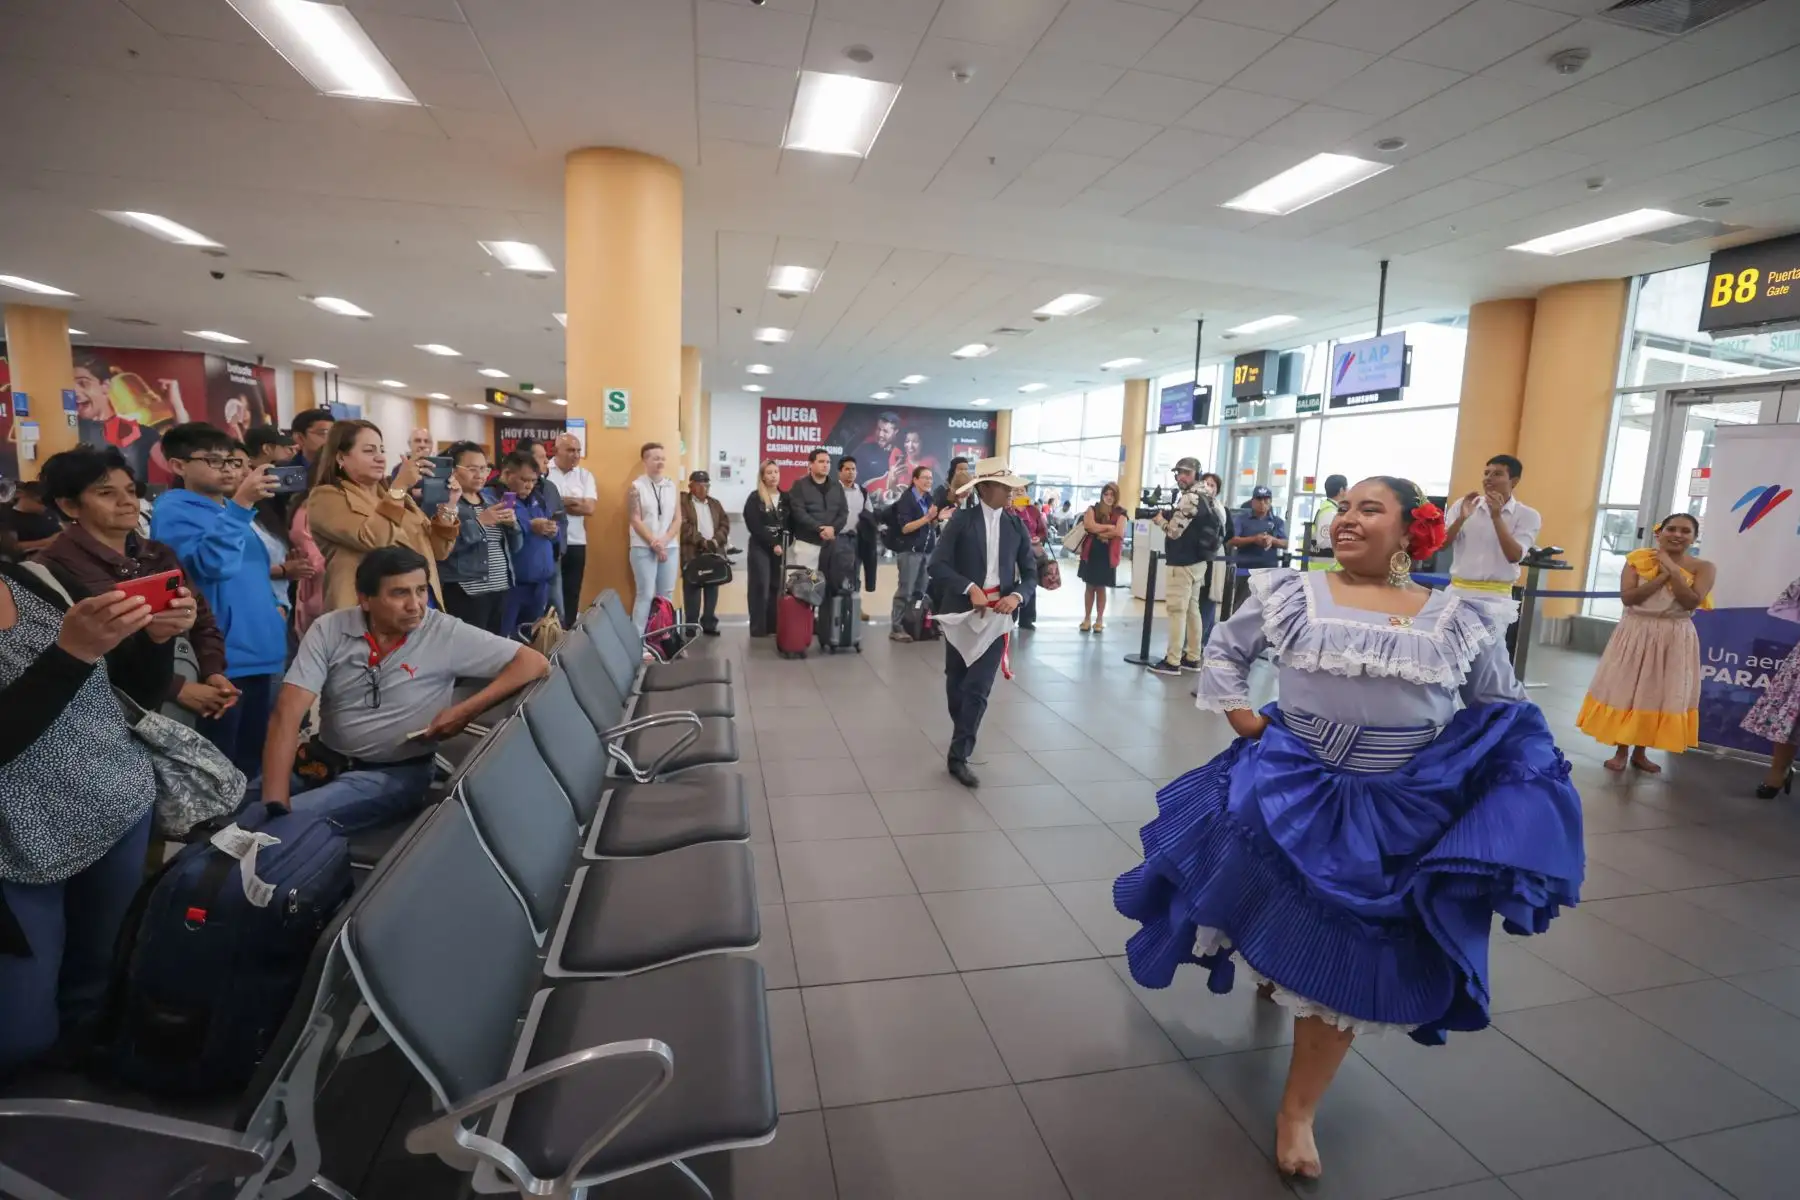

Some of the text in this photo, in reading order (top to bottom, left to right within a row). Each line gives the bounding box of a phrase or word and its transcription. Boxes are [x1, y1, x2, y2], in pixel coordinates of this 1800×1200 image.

[1767, 268, 1800, 284] Puerta
[1710, 268, 1760, 308] B8
[1766, 285, 1790, 297] Gate
[1357, 344, 1390, 365] LAP
[1234, 365, 1249, 385] B7
[608, 391, 626, 413] S
[1297, 398, 1320, 409] SALIDA
[1346, 393, 1379, 405] SAMSUNG
[767, 406, 818, 424] ¡JUEGA
[1225, 406, 1239, 418] EXI
[948, 417, 989, 430] betsafe
[538, 429, 549, 440] TU
[766, 424, 822, 442] ONLINE!
[766, 443, 794, 453] CASINO
[795, 444, 800, 453] Y
[1708, 646, 1790, 670] Un aer
[1700, 664, 1770, 689] PARA
